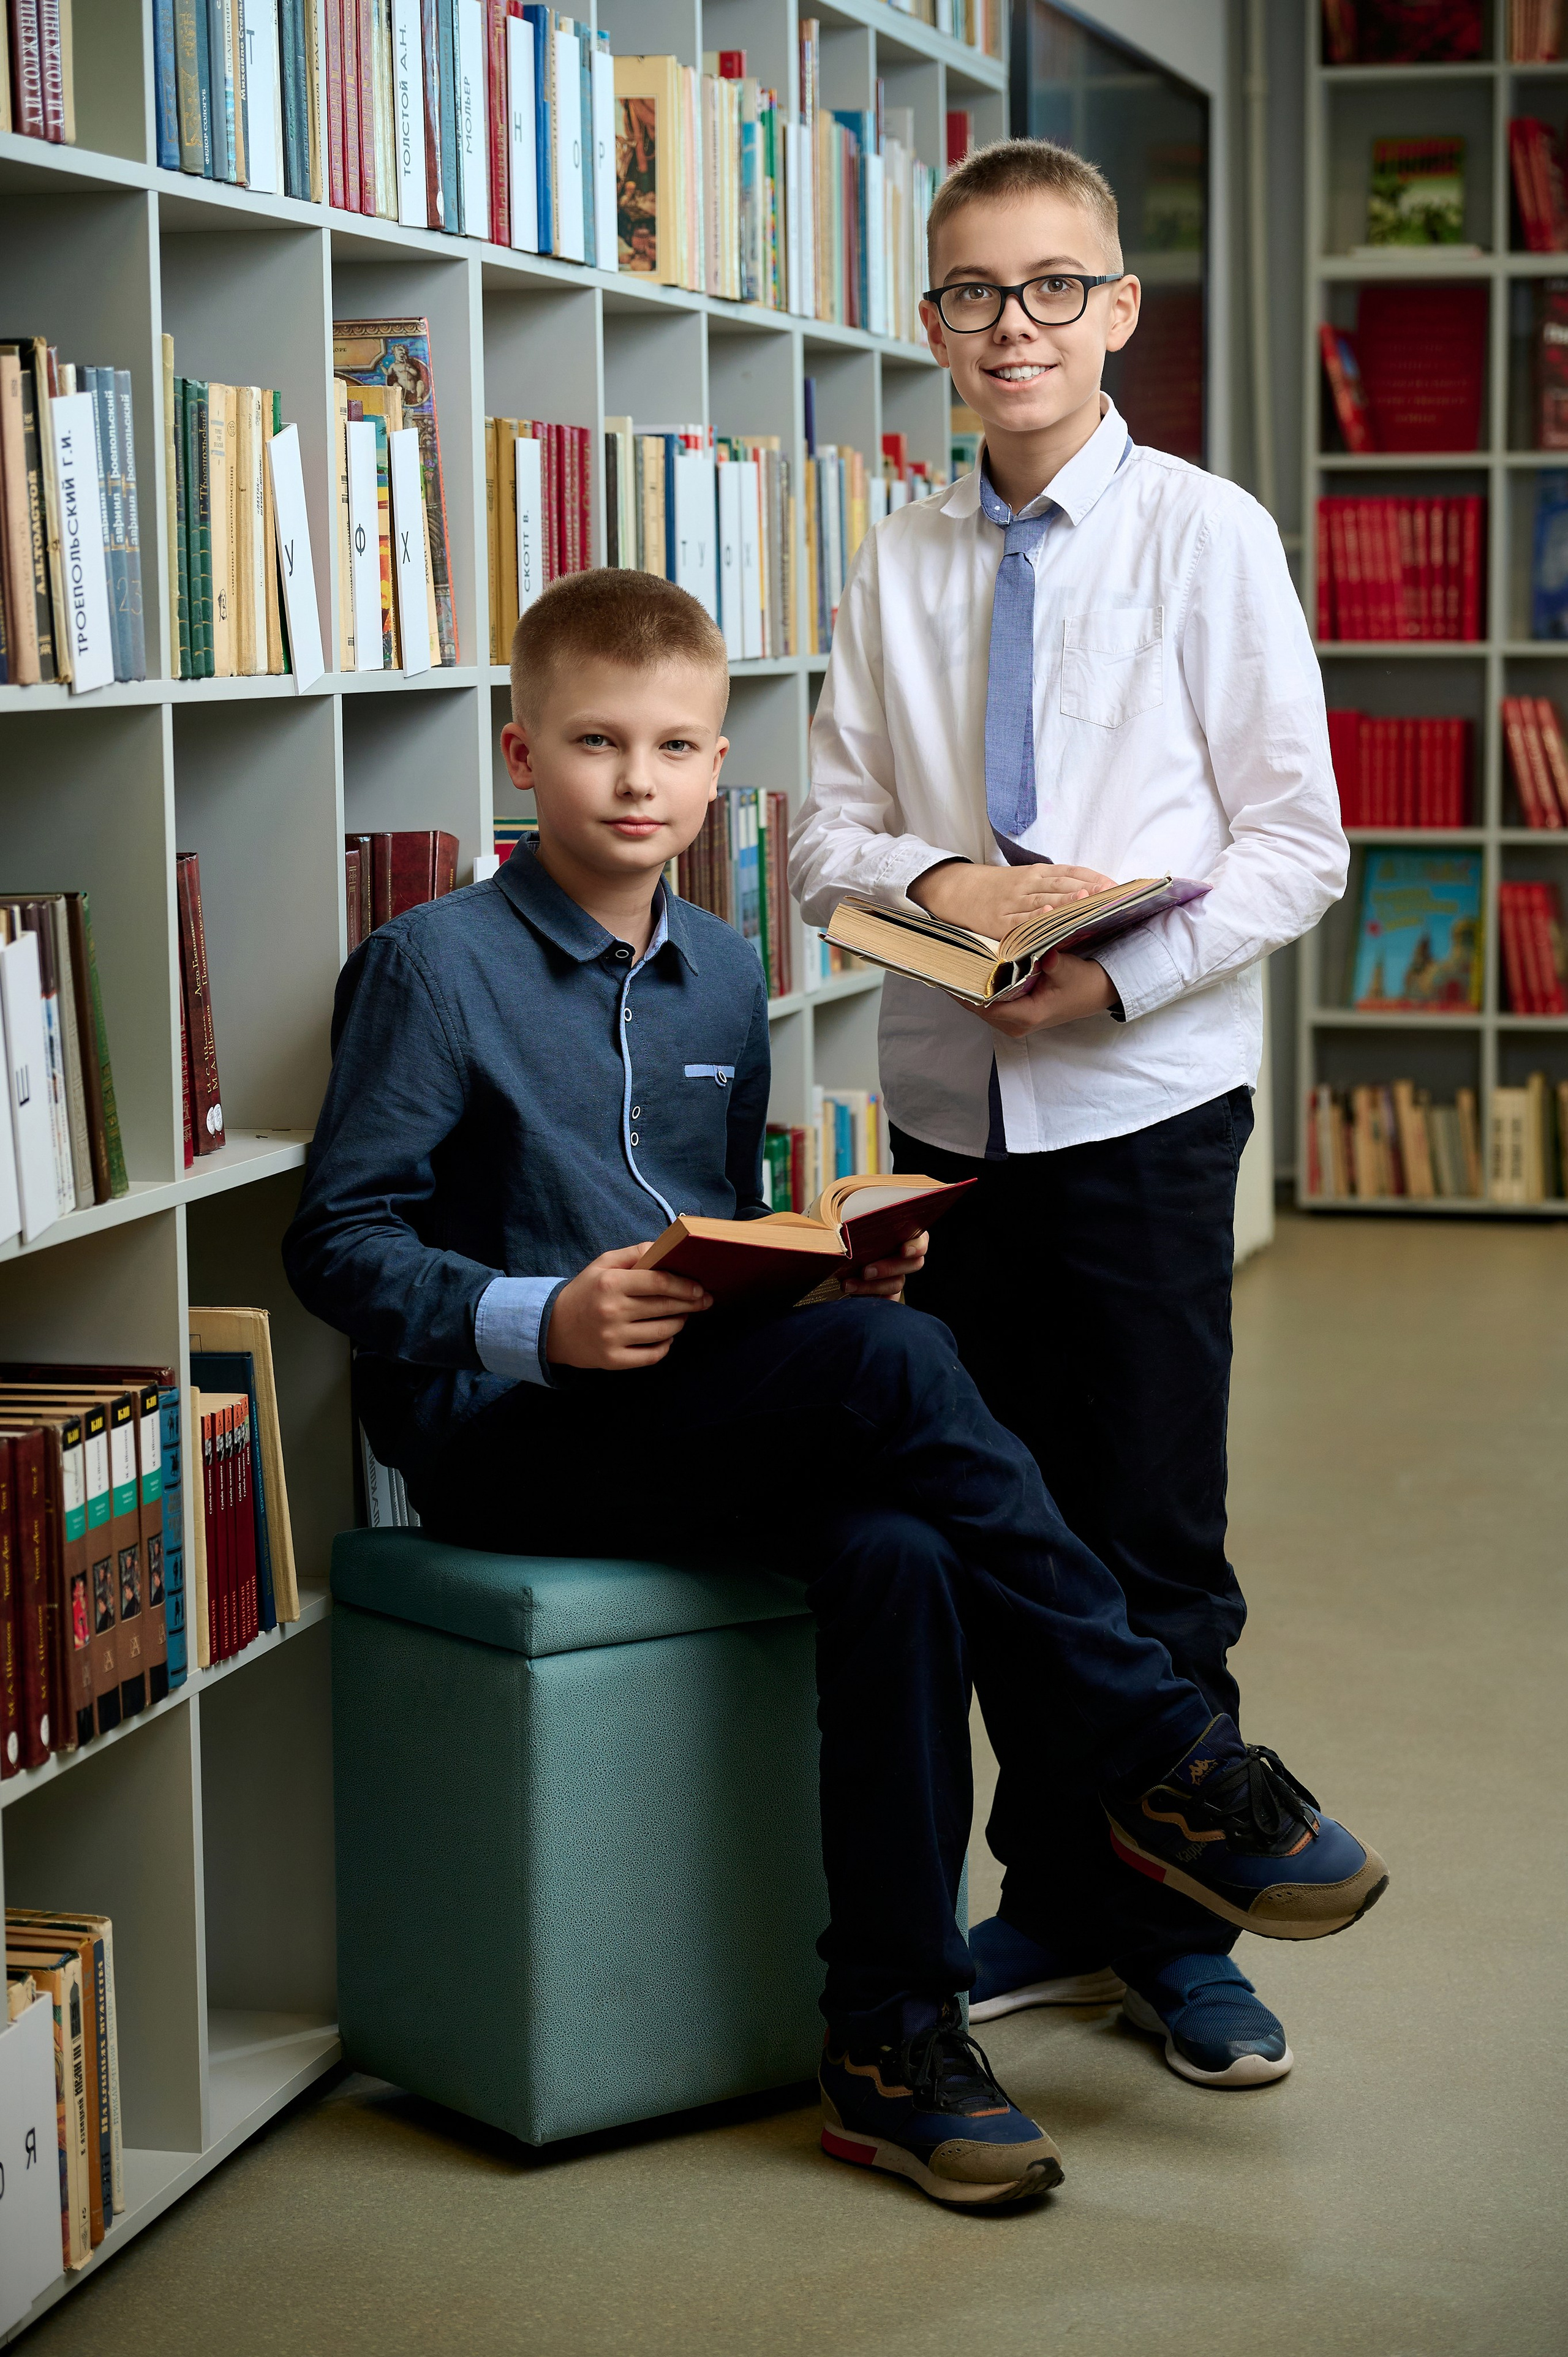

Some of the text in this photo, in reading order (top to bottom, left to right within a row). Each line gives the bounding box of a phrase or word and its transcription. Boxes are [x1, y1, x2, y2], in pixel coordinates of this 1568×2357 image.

[21, 0, 42, 126] А.И.СОЛЖЕНИ
[246, 29, 255, 65] Т
[399, 80, 410, 176] ТОЛСТОЙ
[464, 76, 472, 154] МОЛЬЕР
[514, 111, 522, 143] Н
[599, 141, 605, 168] Р
[103, 390, 126, 550] Гавриил Троепольский
[121, 394, 140, 553] Гавриил Троепольский
[198, 410, 209, 500] Троепольский
[523, 510, 529, 523] В.
[61, 429, 88, 656] ТРОЕПОЛЬСКИЙ Г.И.
[285, 540, 293, 578] У
[355, 524, 366, 556] Ф
[401, 531, 410, 564] Х
[680, 540, 687, 567] Т
[117, 576, 129, 612] 2
[16, 1063, 30, 1107] Ш
[369, 1444, 380, 1527] ШУКШИ
[25, 2127, 37, 2170] Я
